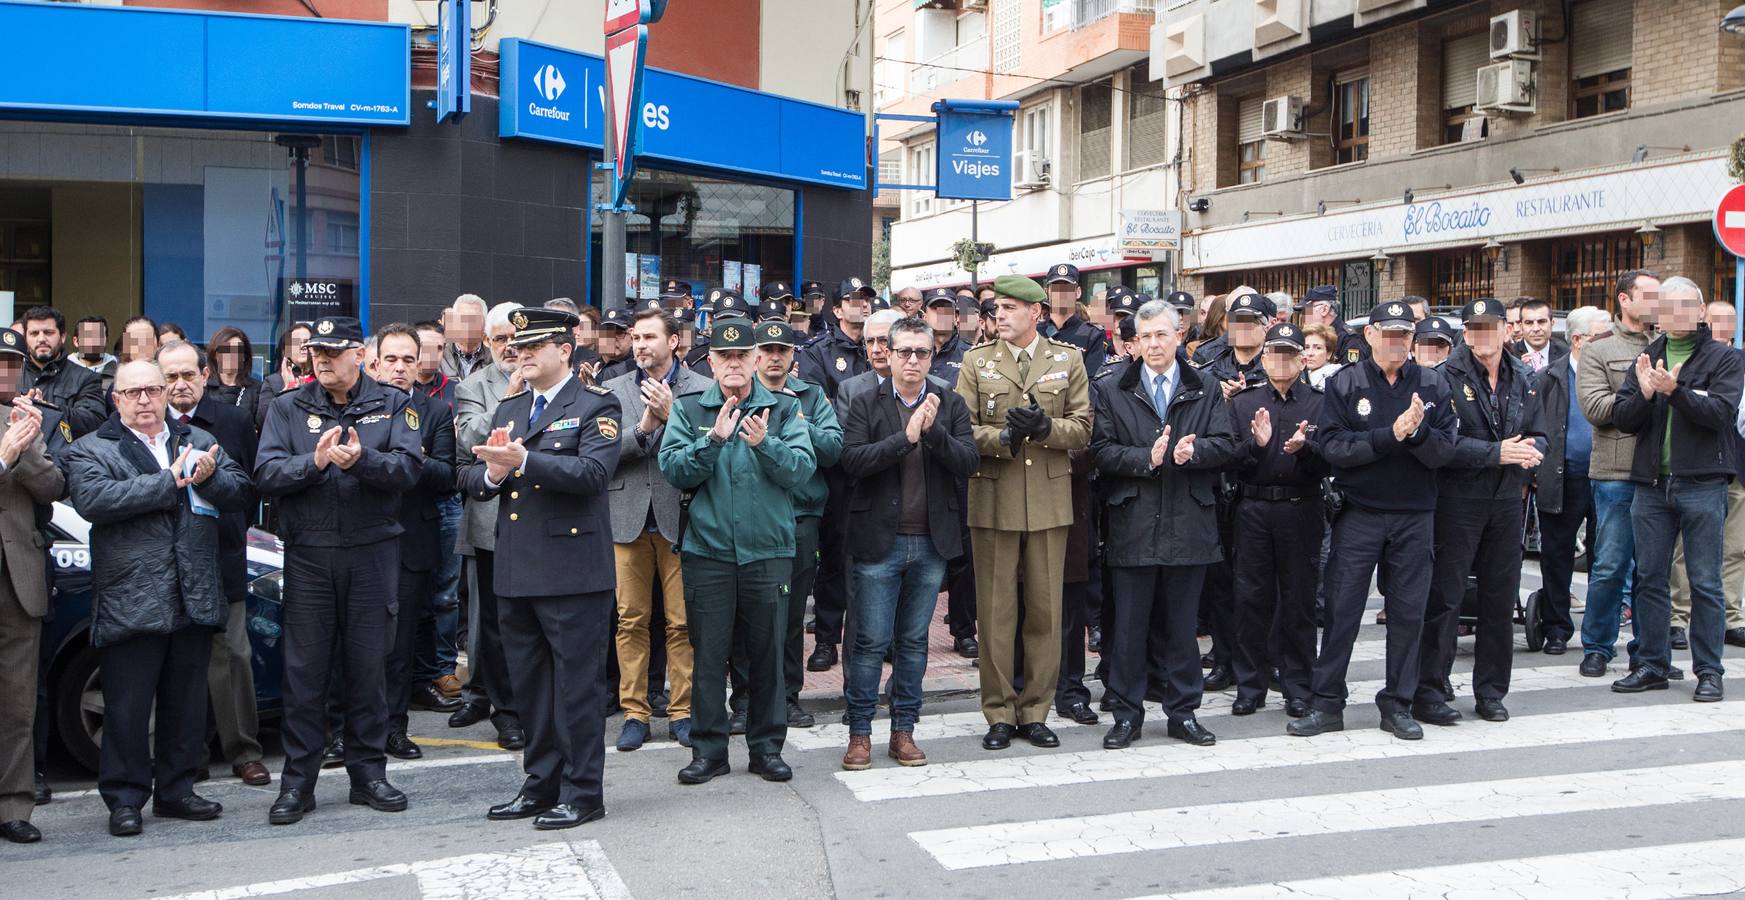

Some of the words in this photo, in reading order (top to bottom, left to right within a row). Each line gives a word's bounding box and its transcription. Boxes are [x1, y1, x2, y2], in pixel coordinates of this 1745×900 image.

[292, 101, 321, 110] Somdos
[323, 103, 345, 111] Travel
[529, 102, 570, 121] Carrefour
[952, 160, 999, 178] Viajes
[1516, 190, 1605, 218] RESTAURANTE
[1404, 205, 1424, 242] El
[304, 283, 336, 294] MSC
[57, 550, 89, 568] 09
